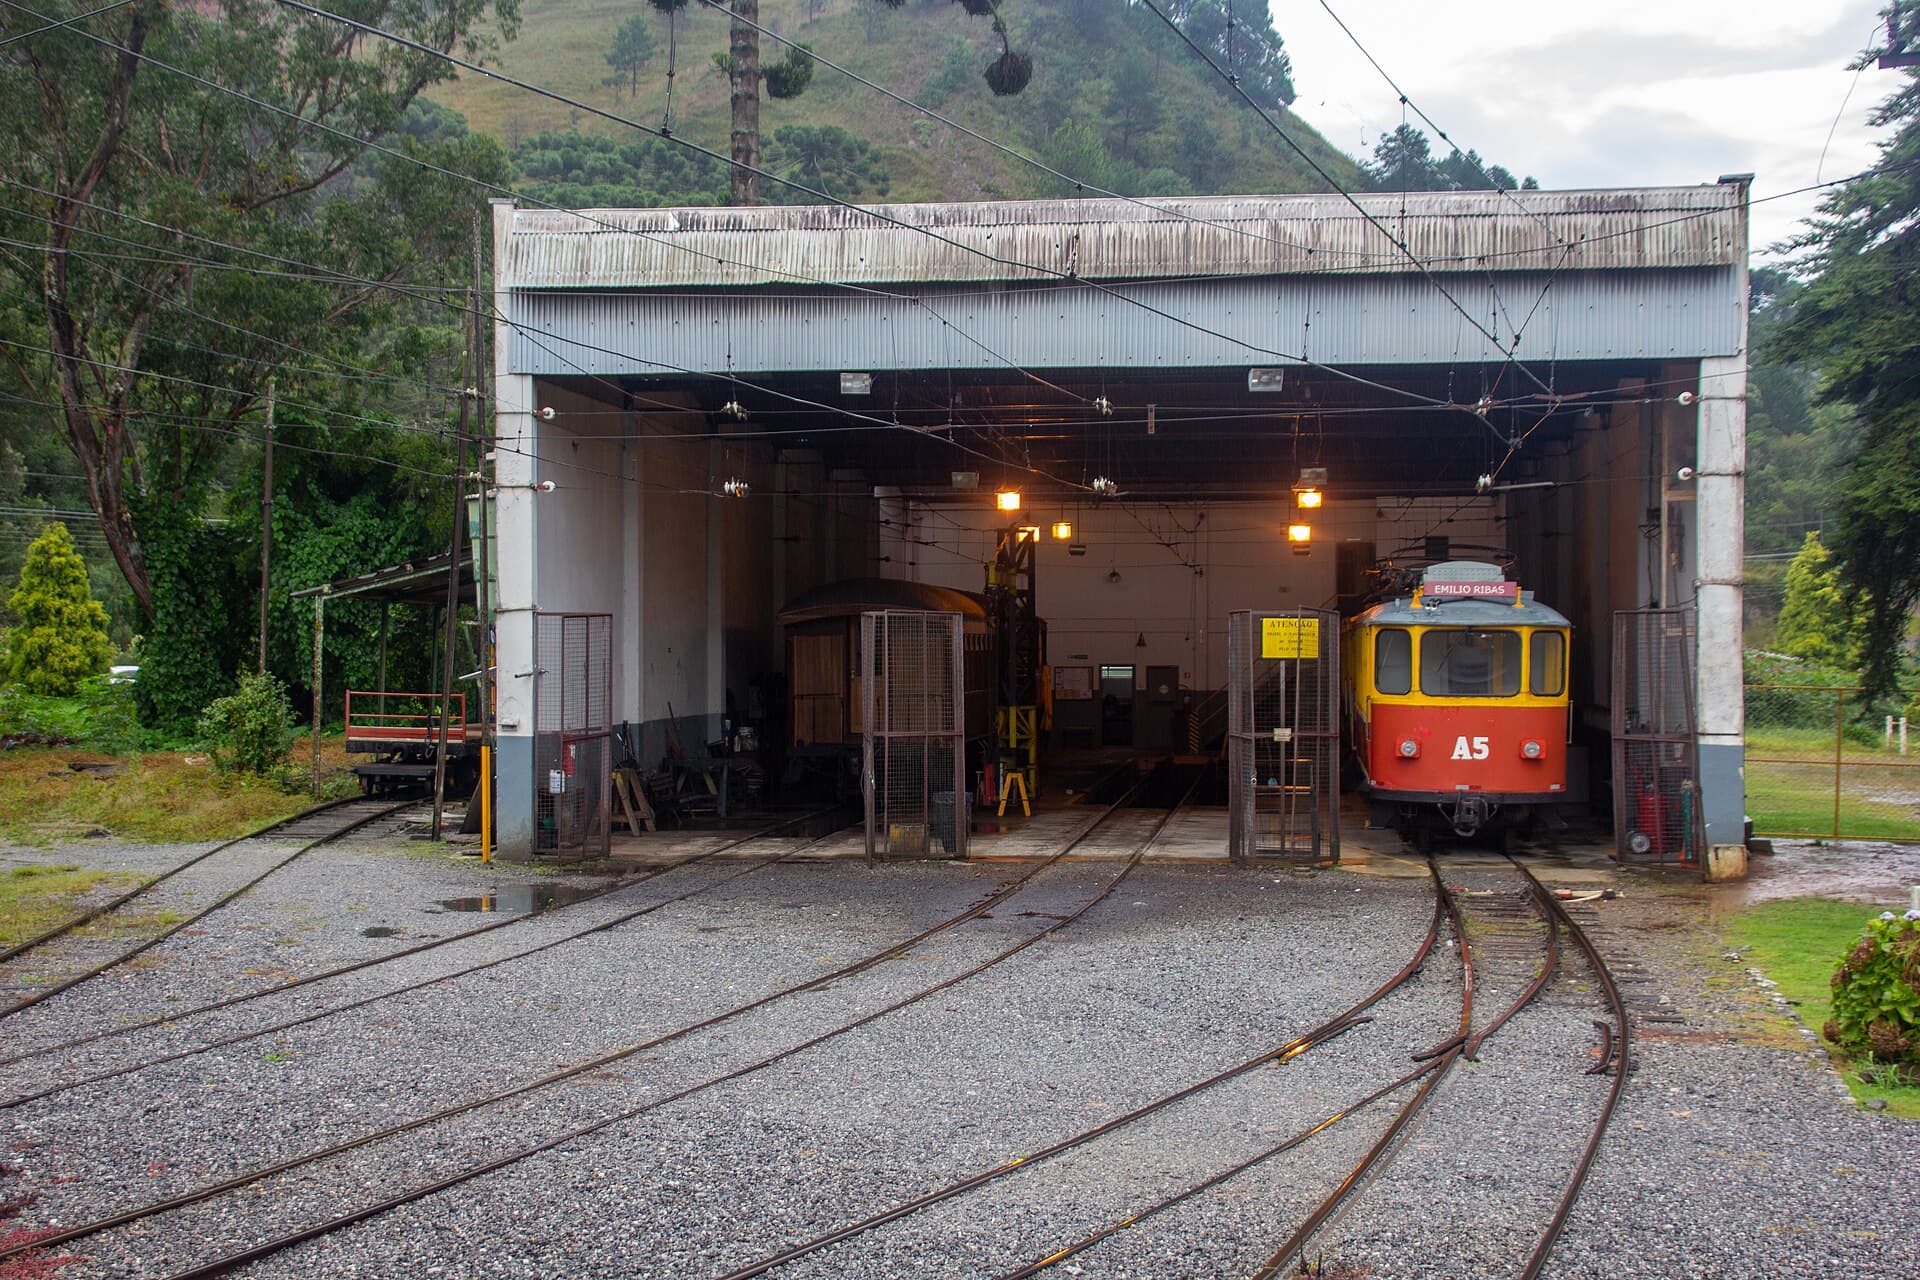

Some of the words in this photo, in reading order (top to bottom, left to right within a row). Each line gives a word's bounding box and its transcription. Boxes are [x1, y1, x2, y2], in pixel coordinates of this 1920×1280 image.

[1435, 585, 1471, 594] EMILIO
[1473, 585, 1505, 594] RIBAS
[1451, 736, 1489, 760] A5
